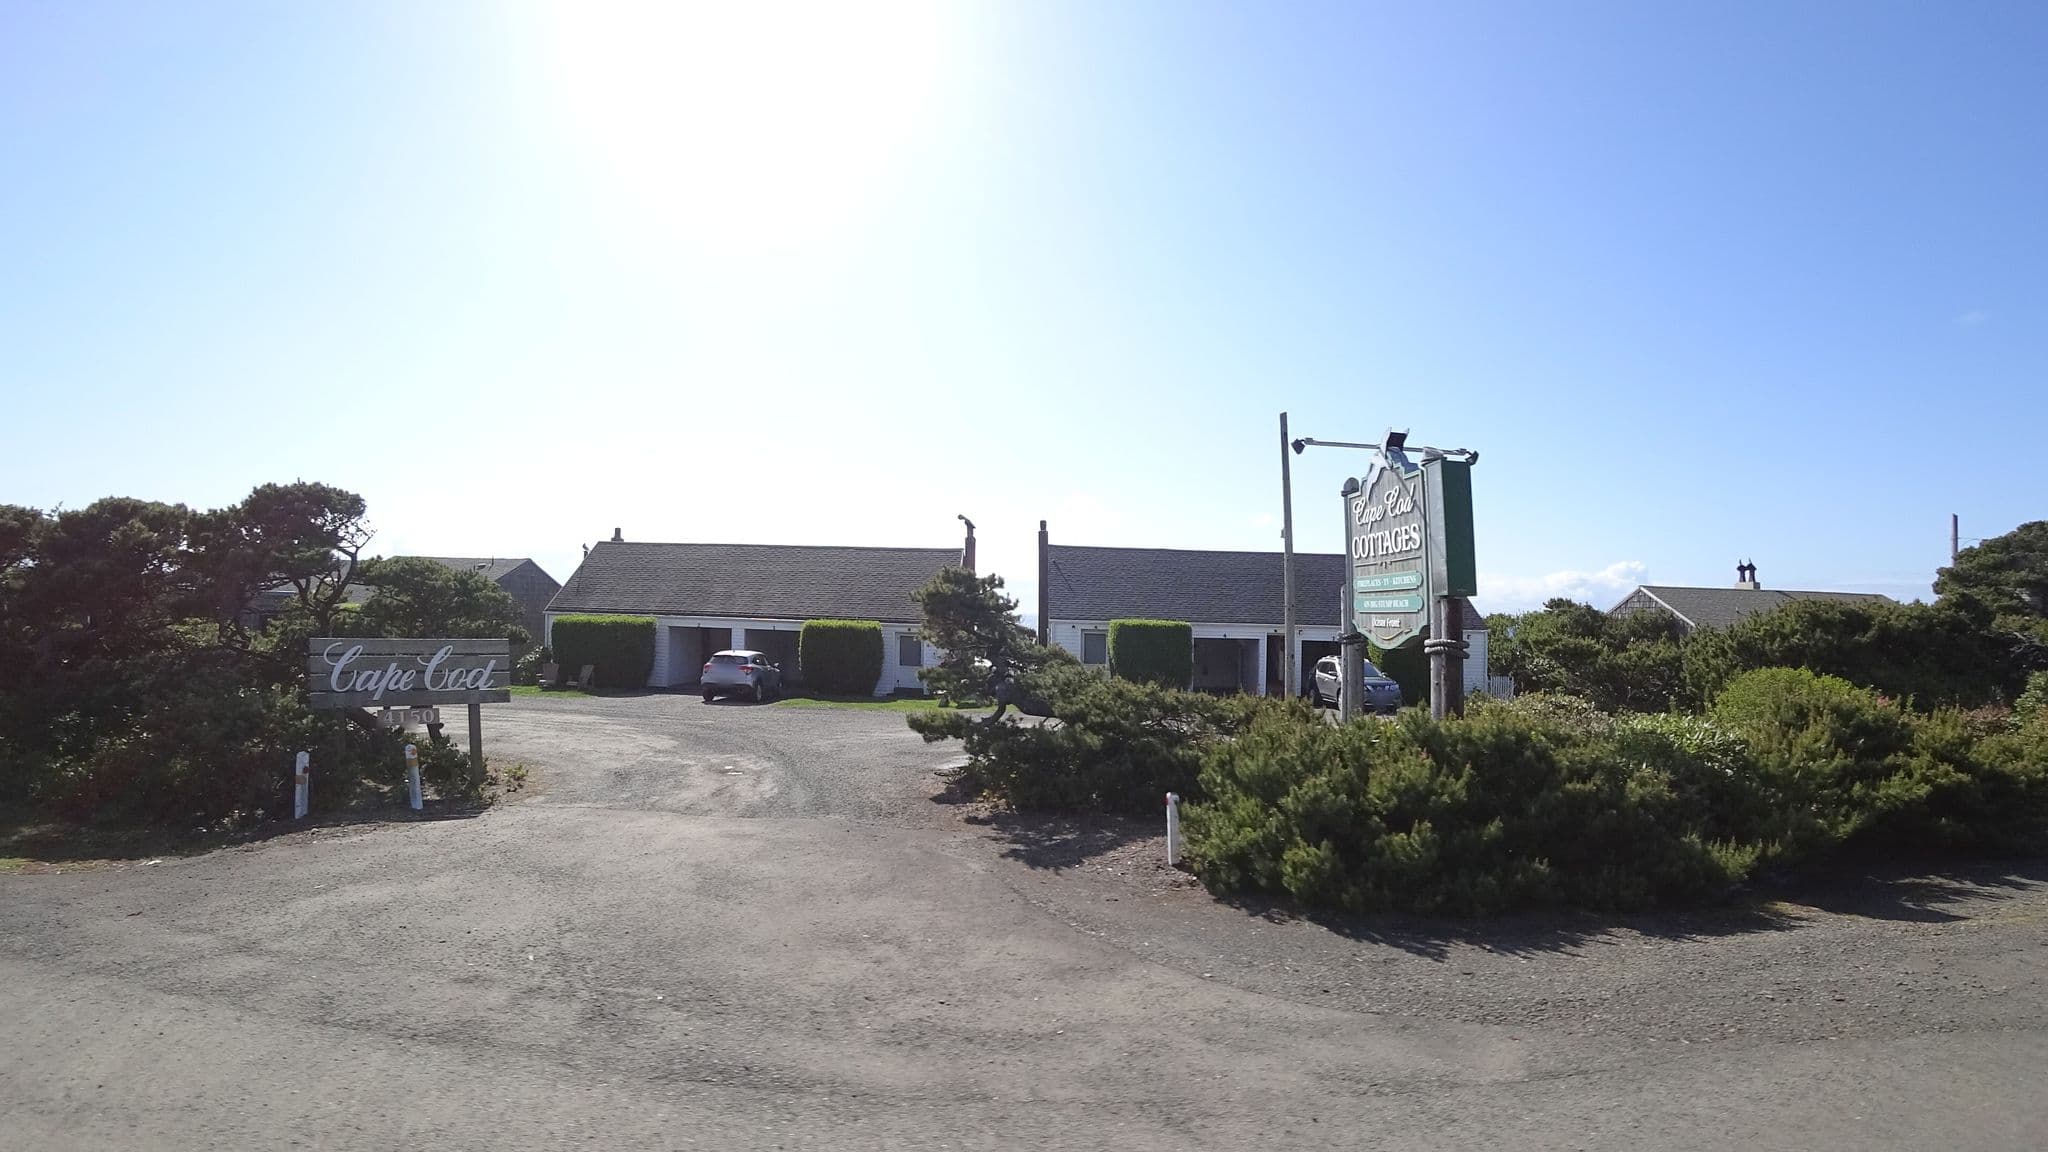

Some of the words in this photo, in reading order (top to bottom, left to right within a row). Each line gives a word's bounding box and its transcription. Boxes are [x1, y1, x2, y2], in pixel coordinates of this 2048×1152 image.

[1353, 498, 1384, 532] Cape
[1384, 482, 1416, 517] Cod
[1352, 523, 1421, 559] COTTAGES
[323, 642, 416, 700] Cape
[417, 644, 497, 691] Cod
[383, 709, 435, 723] 4150
